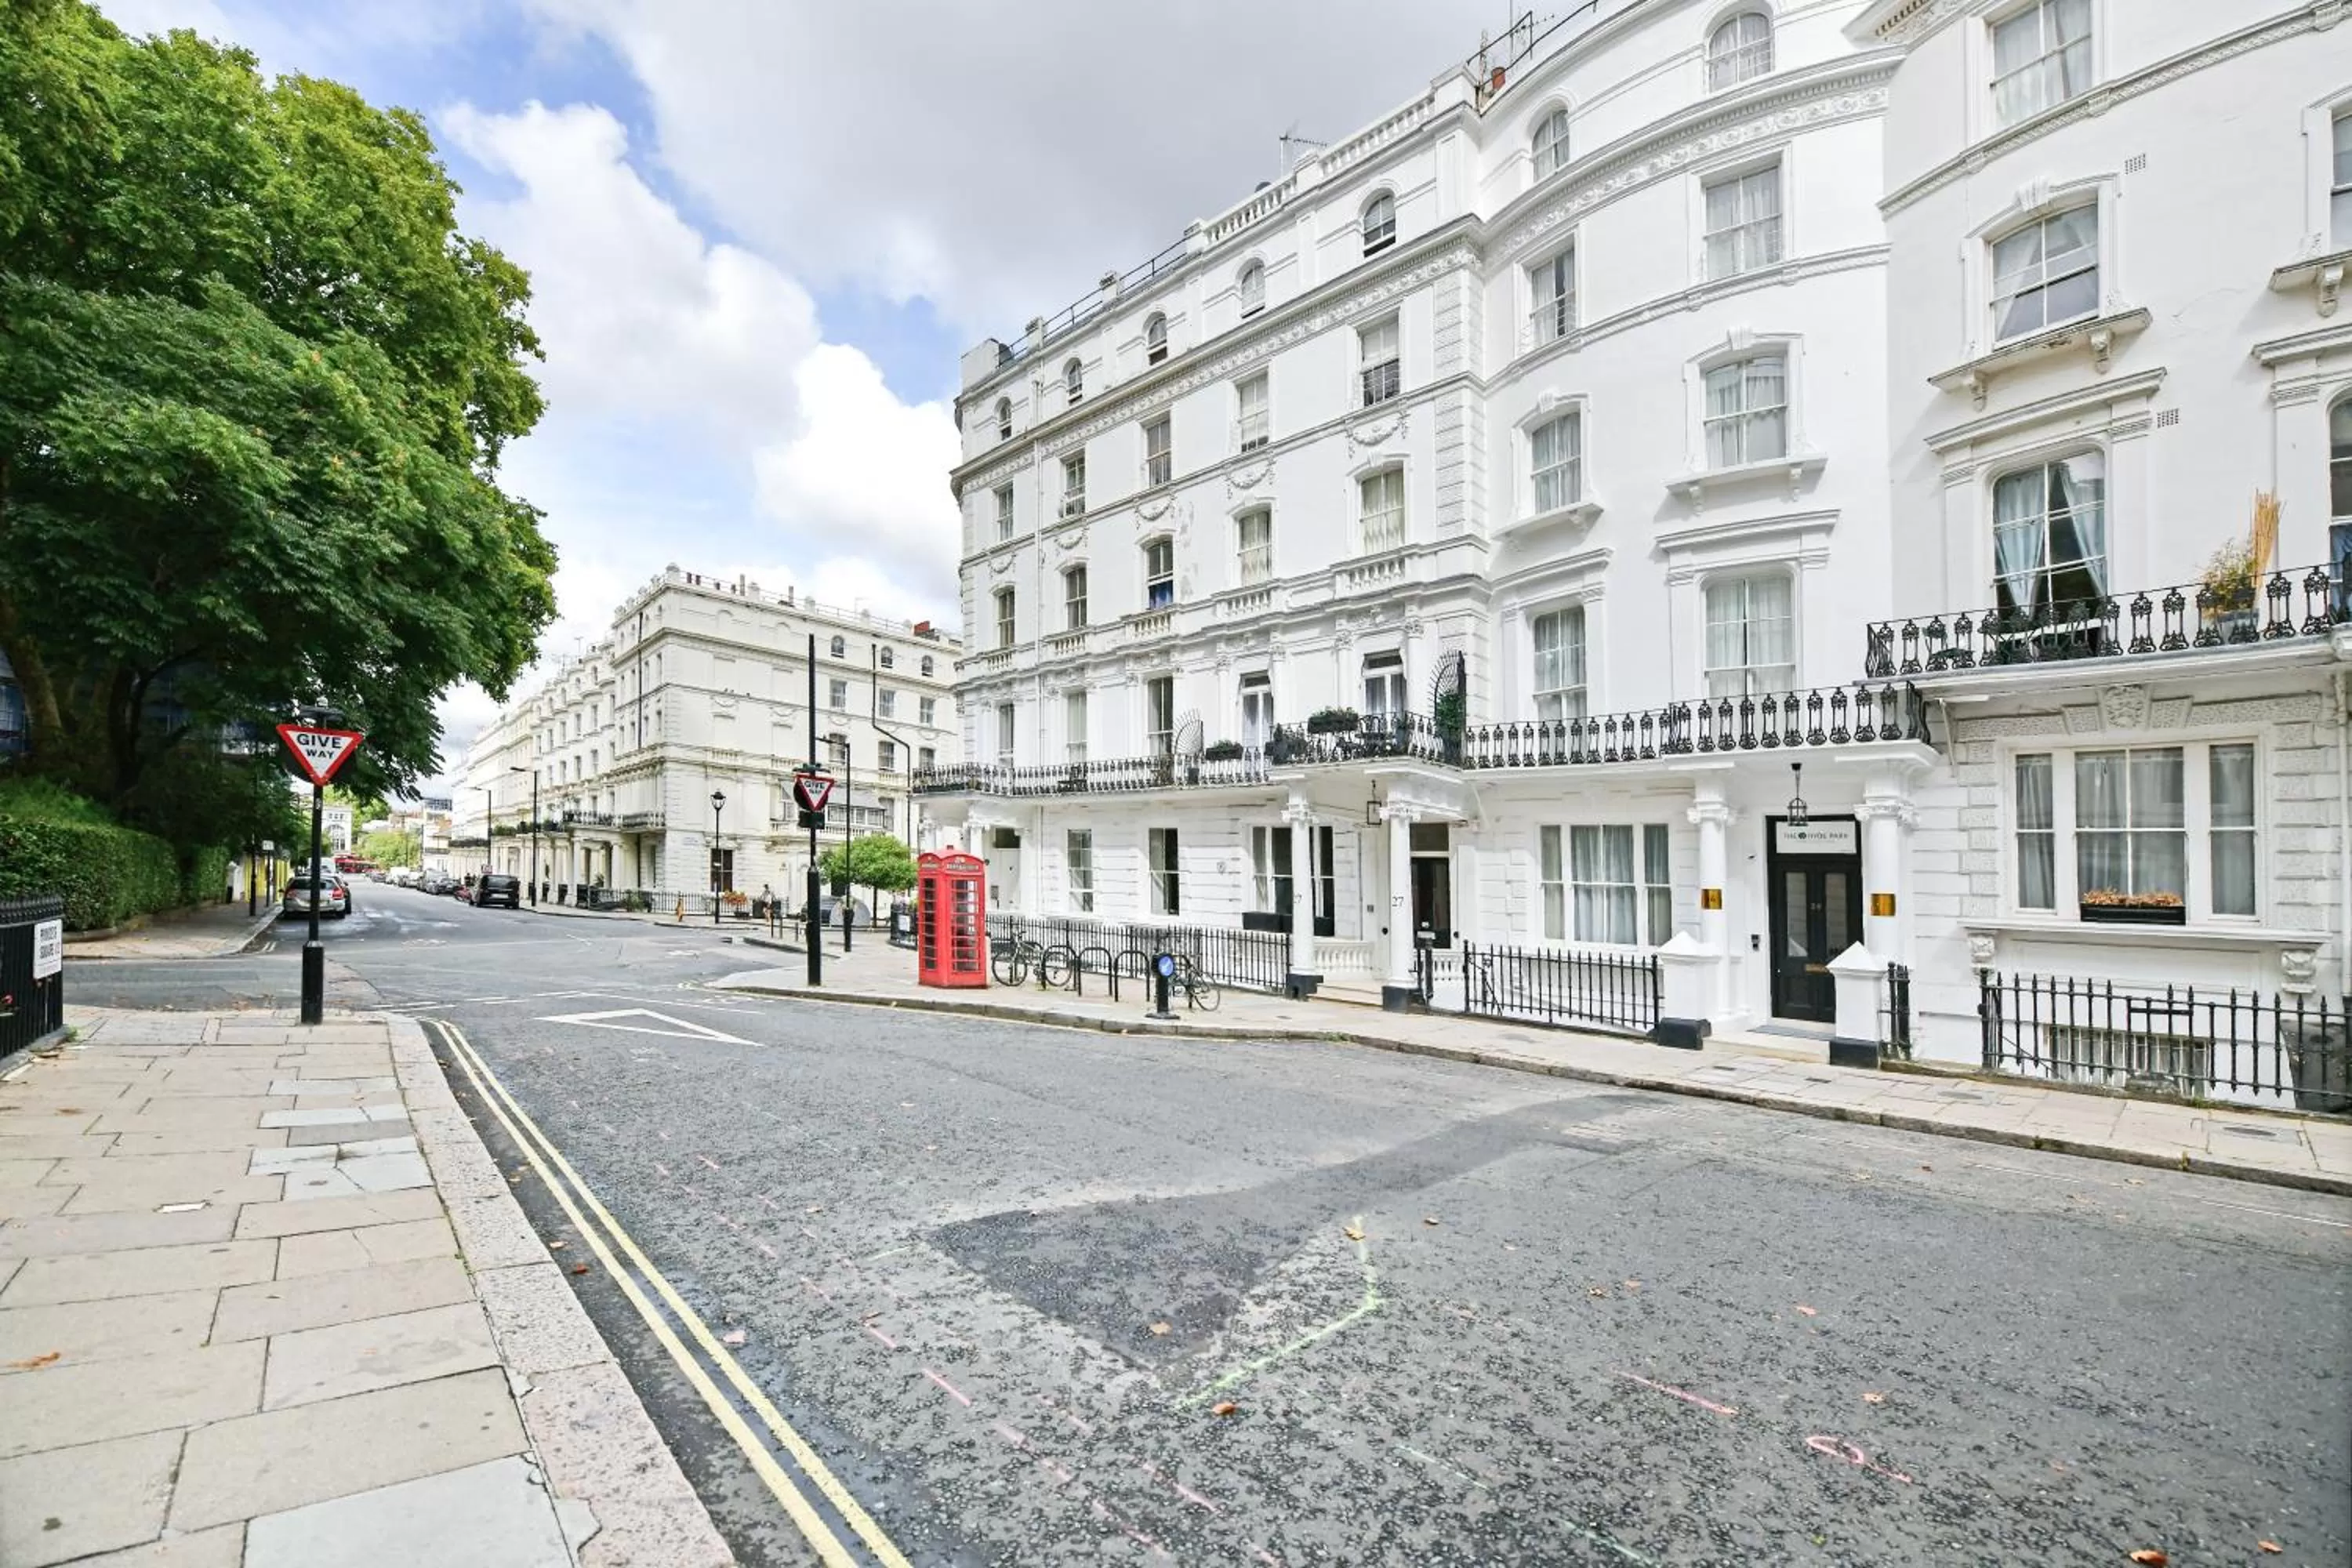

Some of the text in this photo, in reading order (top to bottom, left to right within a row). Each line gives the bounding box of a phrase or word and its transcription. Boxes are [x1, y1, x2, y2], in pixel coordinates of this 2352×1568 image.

[296, 733, 342, 749] GIVE
[306, 749, 335, 760] WAY
[804, 780, 826, 789] GIVE
[1392, 896, 1404, 907] 27
